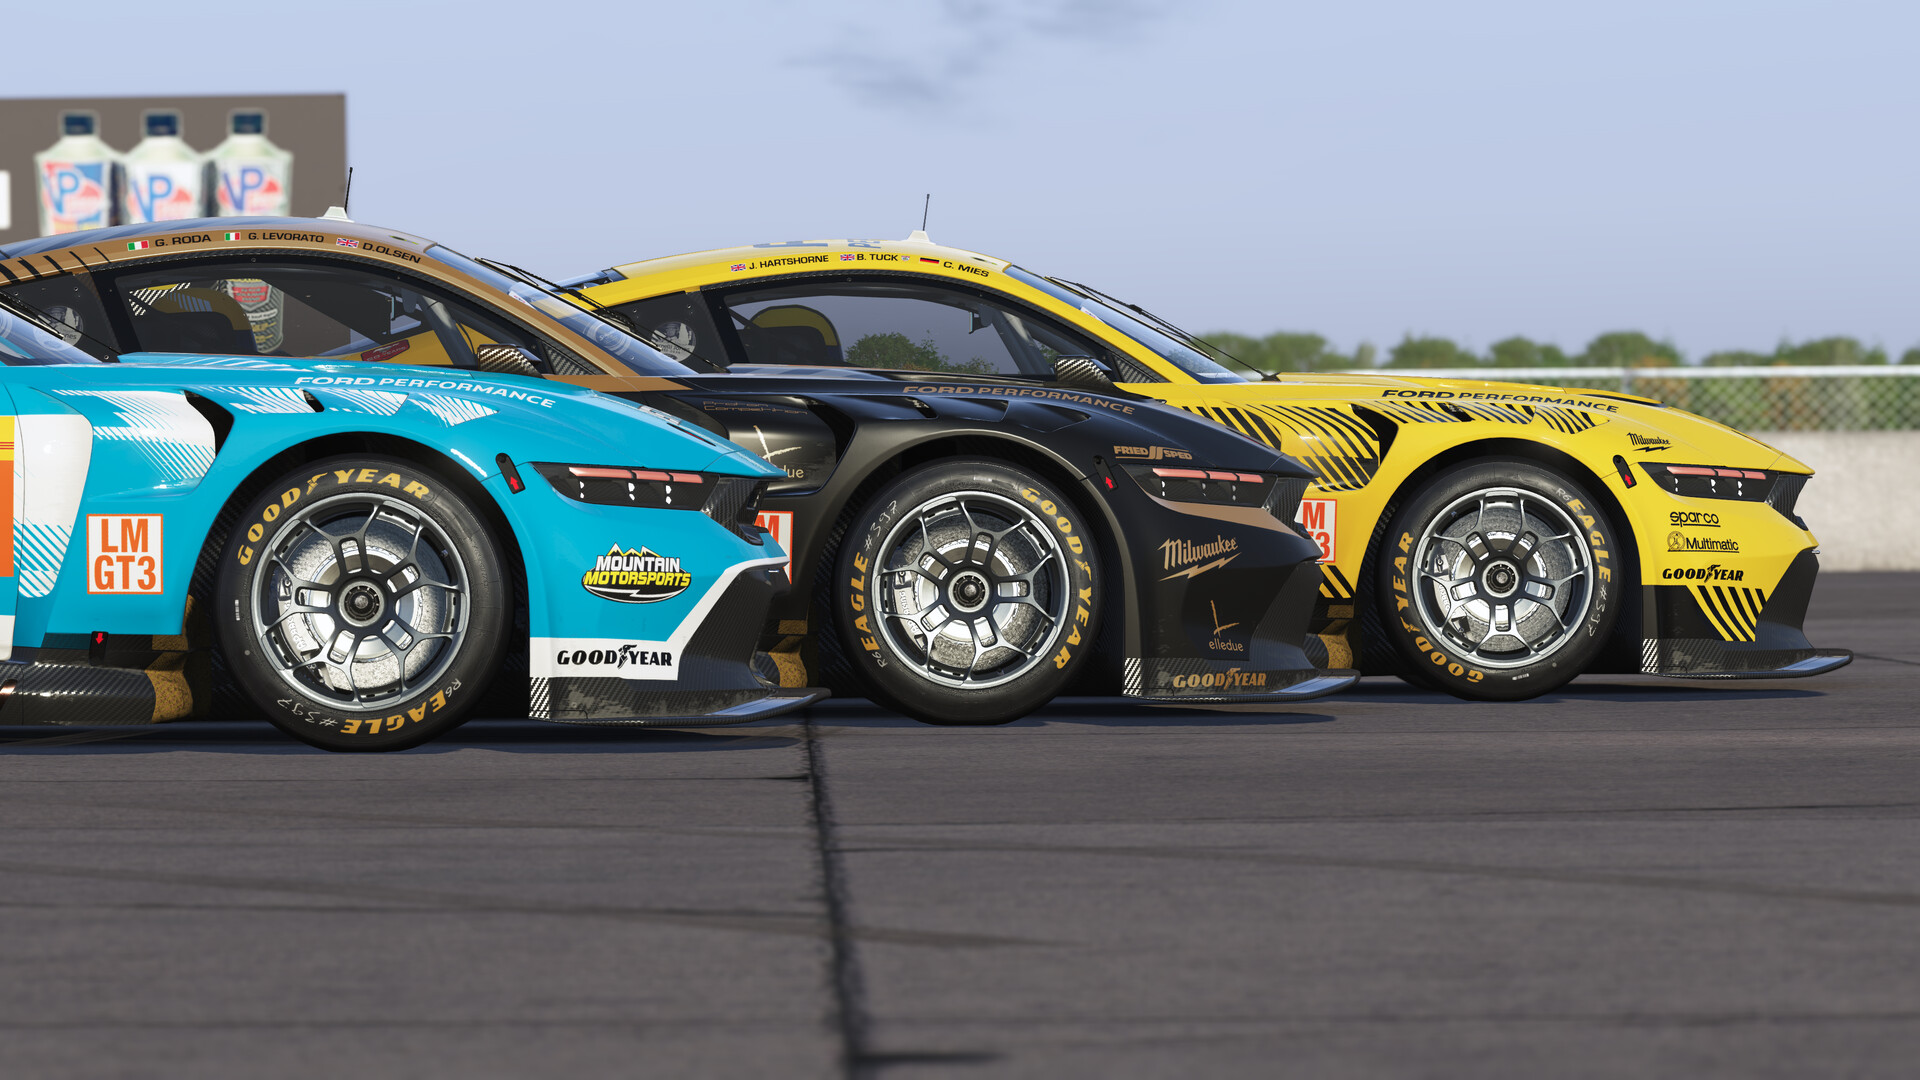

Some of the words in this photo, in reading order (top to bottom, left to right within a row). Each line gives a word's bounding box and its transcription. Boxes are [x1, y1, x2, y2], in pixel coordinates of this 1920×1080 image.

[154, 238, 169, 247] G.
[172, 234, 212, 245] RODA
[248, 232, 262, 240] G.
[263, 232, 324, 243] LEVORATO
[760, 254, 829, 269] HARTSHORNE
[856, 253, 867, 261] B.
[942, 261, 954, 269] C.
[958, 264, 989, 278] MIES
[294, 376, 376, 385] FORD
[378, 378, 556, 408] PERFORMANCE
[902, 386, 974, 394] FORD
[977, 387, 1135, 415] PERFORMANCE
[1381, 389, 1455, 399] FORD
[1457, 392, 1619, 413] PERFORMANCE
[1626, 432, 1671, 446] Milwaukee
[1113, 445, 1149, 456] FRIED
[1163, 449, 1193, 460] SPED
[1302, 501, 1326, 530] M
[1669, 511, 1720, 528] sparco
[101, 518, 149, 553] LM
[1566, 498, 1611, 583] EAGLE
[1685, 537, 1739, 551] Multimatic
[1157, 534, 1239, 571] Milwaukee
[94, 554, 157, 590] GT3
[594, 555, 680, 573] MOUNTAIN
[583, 571, 691, 587] MOTORSPORTS
[850, 551, 881, 652] EAGLE
[1208, 638, 1244, 652] elledue
[340, 689, 447, 734] EAGLE
